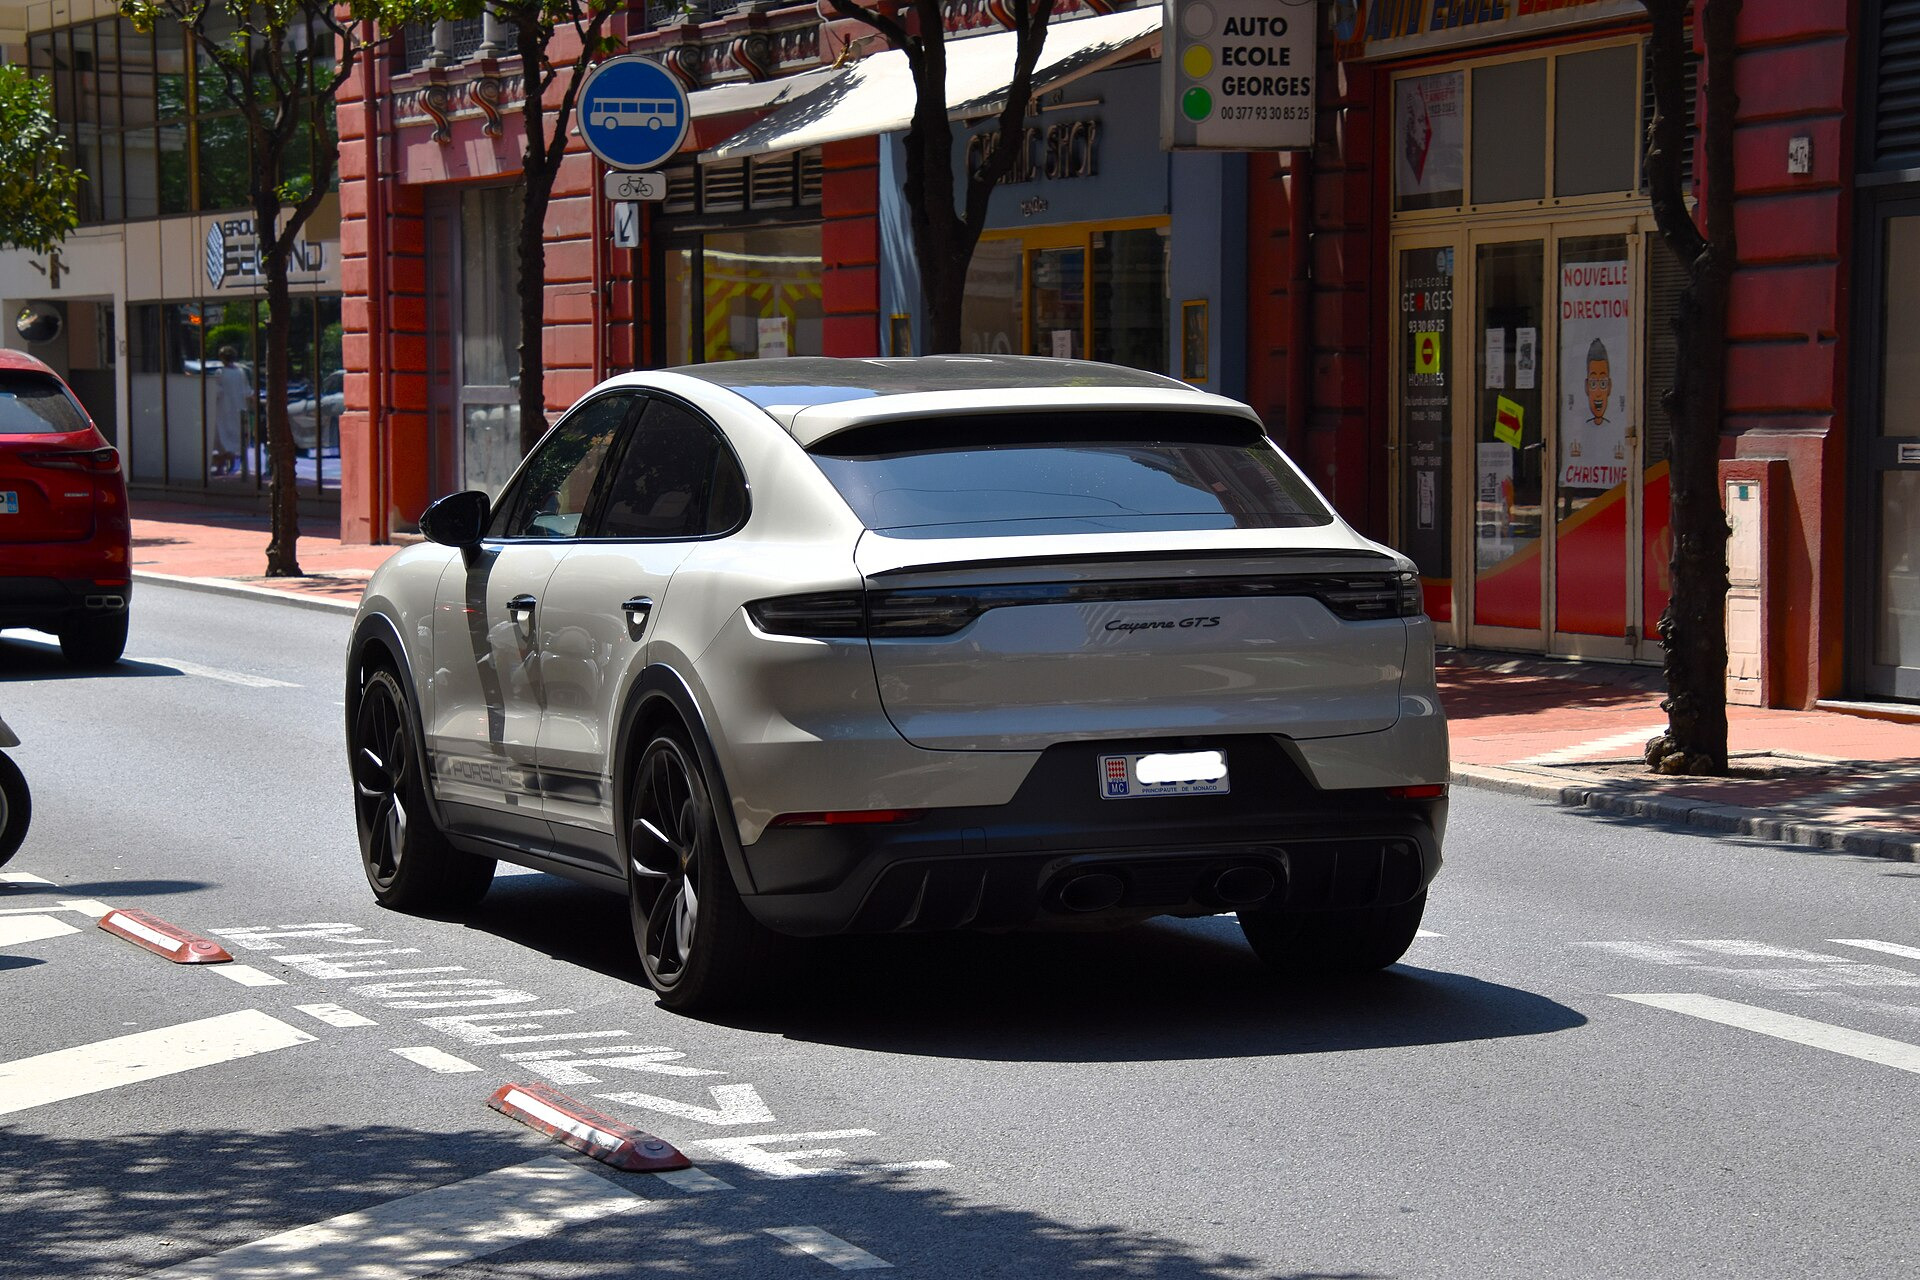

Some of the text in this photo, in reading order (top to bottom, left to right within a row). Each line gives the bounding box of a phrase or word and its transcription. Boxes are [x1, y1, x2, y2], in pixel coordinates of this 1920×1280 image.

[1222, 17, 1288, 37] AUTO
[1222, 47, 1290, 66] ECOLE
[1221, 76, 1311, 97] GEORGES
[1221, 106, 1310, 120] 00 377 93 30 85 25
[224, 239, 323, 276] SEND
[1405, 276, 1449, 288] AUTO-ECOLE
[1564, 266, 1628, 287] NOUVELLE
[1401, 290, 1453, 312] GEORGES
[1563, 299, 1629, 319] DIRECTION
[1408, 320, 1418, 333] 93
[1418, 320, 1427, 333] 30
[1408, 373, 1444, 386] HORAIRES
[1566, 464, 1629, 484] CHRISTINE
[1104, 616, 1221, 634] Cayenne GTS
[453, 760, 525, 788] PORSCHE
[1111, 783, 1125, 793] MC
